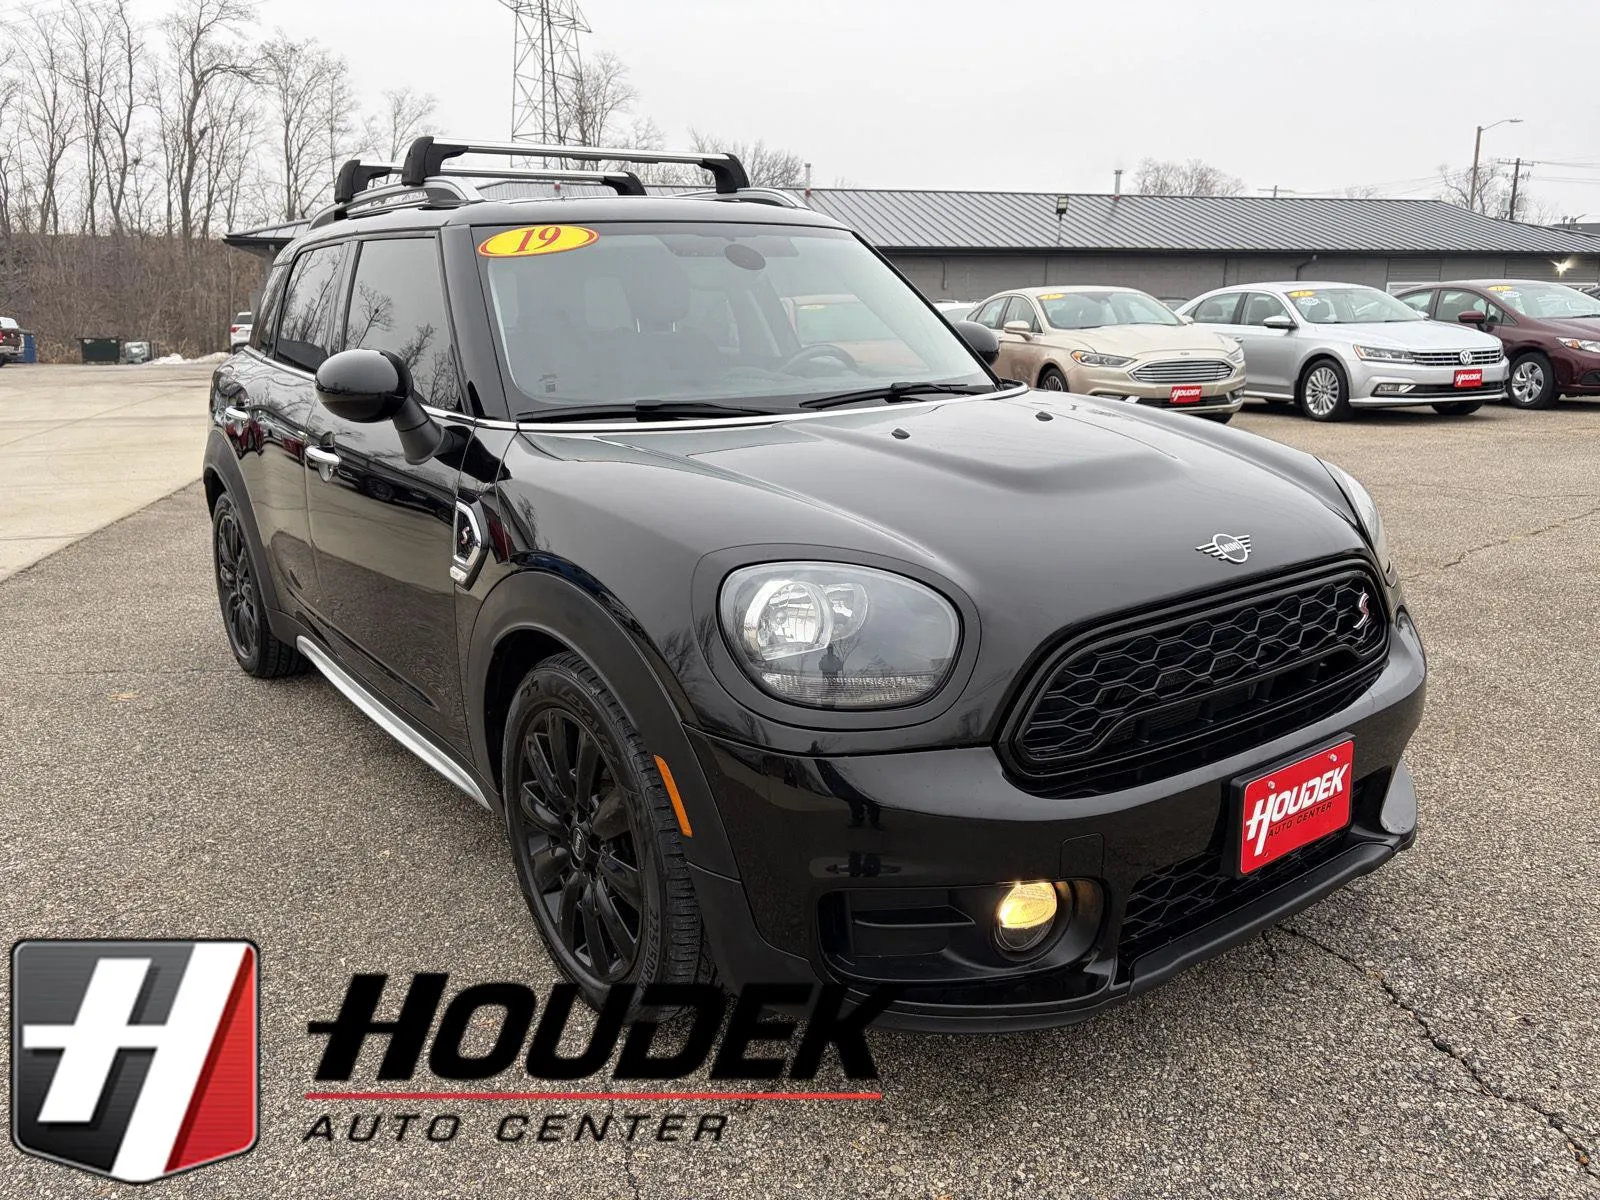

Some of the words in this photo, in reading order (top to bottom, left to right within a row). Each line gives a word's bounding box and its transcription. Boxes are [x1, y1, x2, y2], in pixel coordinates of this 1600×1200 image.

[512, 226, 561, 253] 19
[1246, 763, 1350, 857] HOUDEK
[1268, 820, 1293, 837] AUTO
[1296, 801, 1333, 824] CENTER
